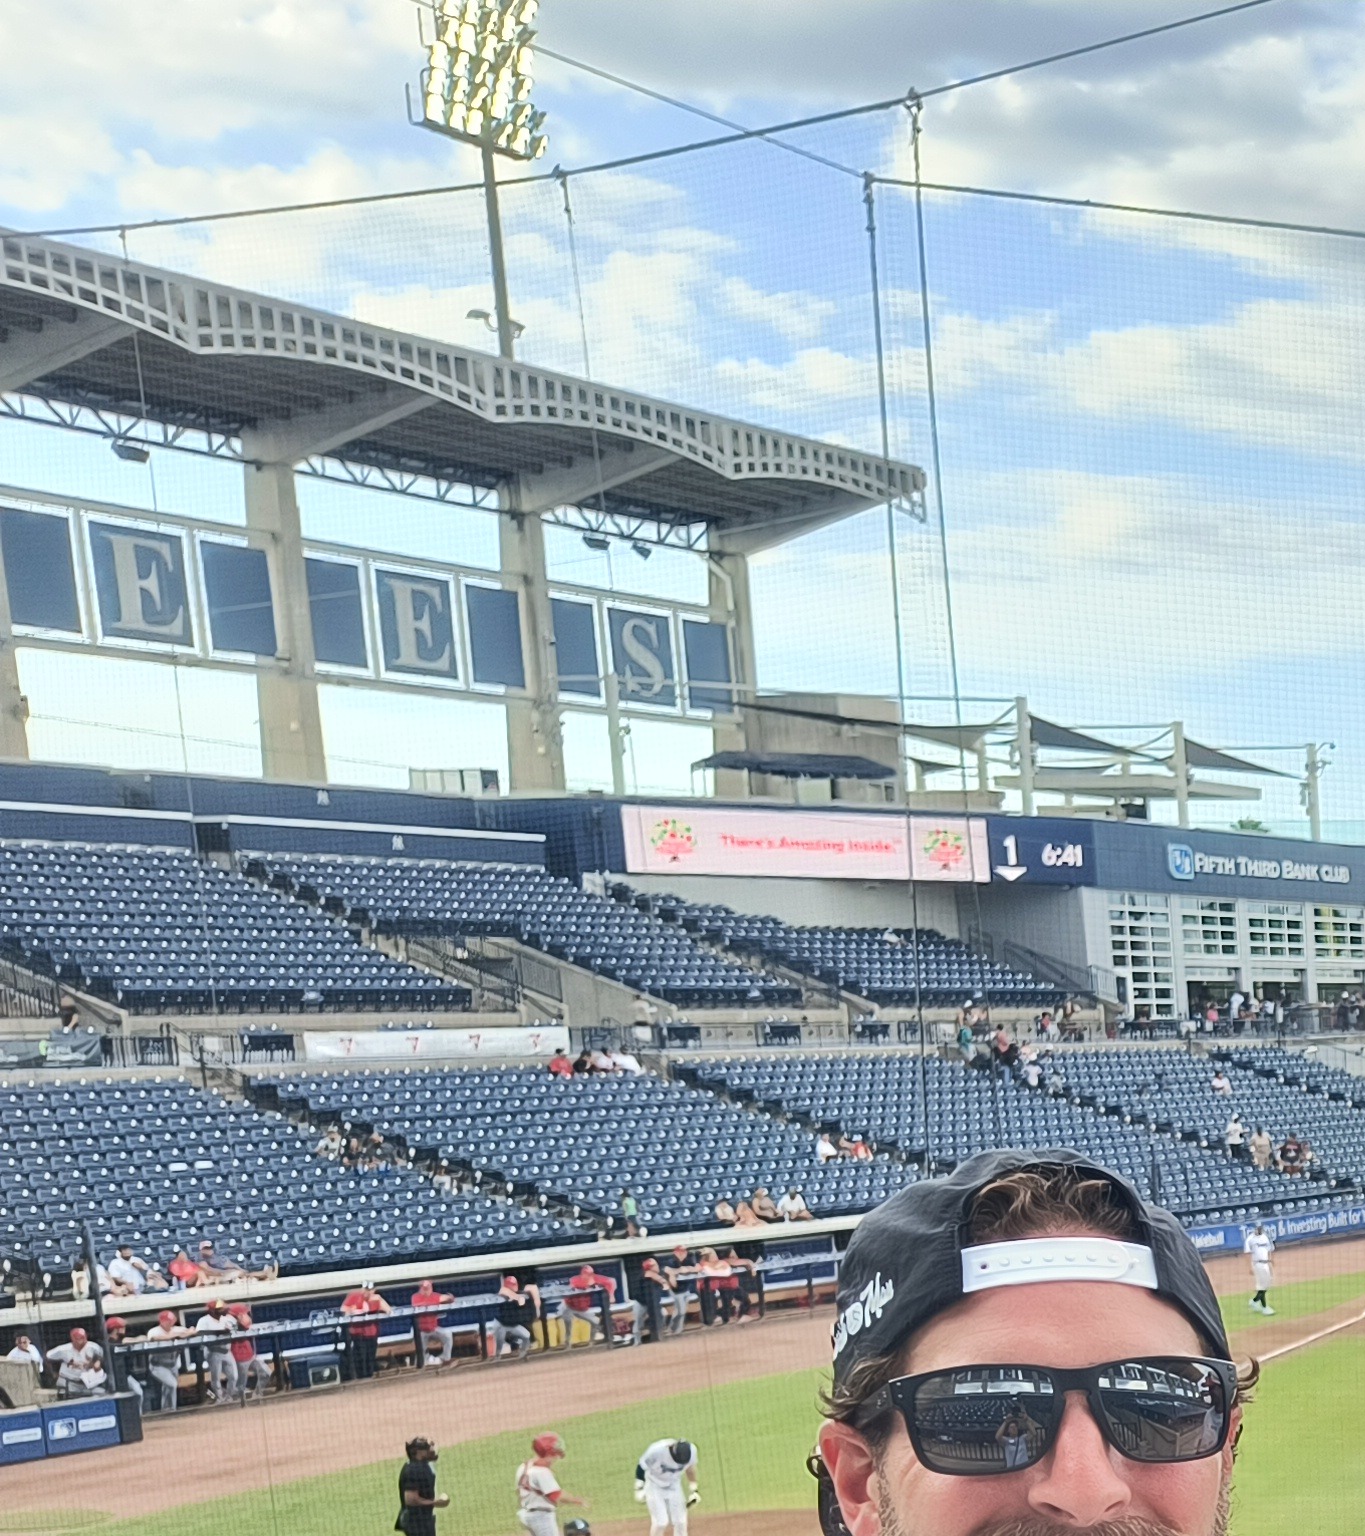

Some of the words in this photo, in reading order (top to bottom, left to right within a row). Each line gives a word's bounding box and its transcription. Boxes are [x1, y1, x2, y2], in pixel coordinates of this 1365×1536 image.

[1003, 835, 1018, 866] 1
[1041, 843, 1084, 867] 6:41
[1194, 851, 1236, 874] FIFTH
[1238, 856, 1281, 879] THIRD
[1281, 860, 1320, 882] BANK
[1323, 864, 1350, 884] CLUB
[1286, 1215, 1327, 1235] Investing
[1328, 1211, 1347, 1231] Built
[1348, 1209, 1361, 1226] for
